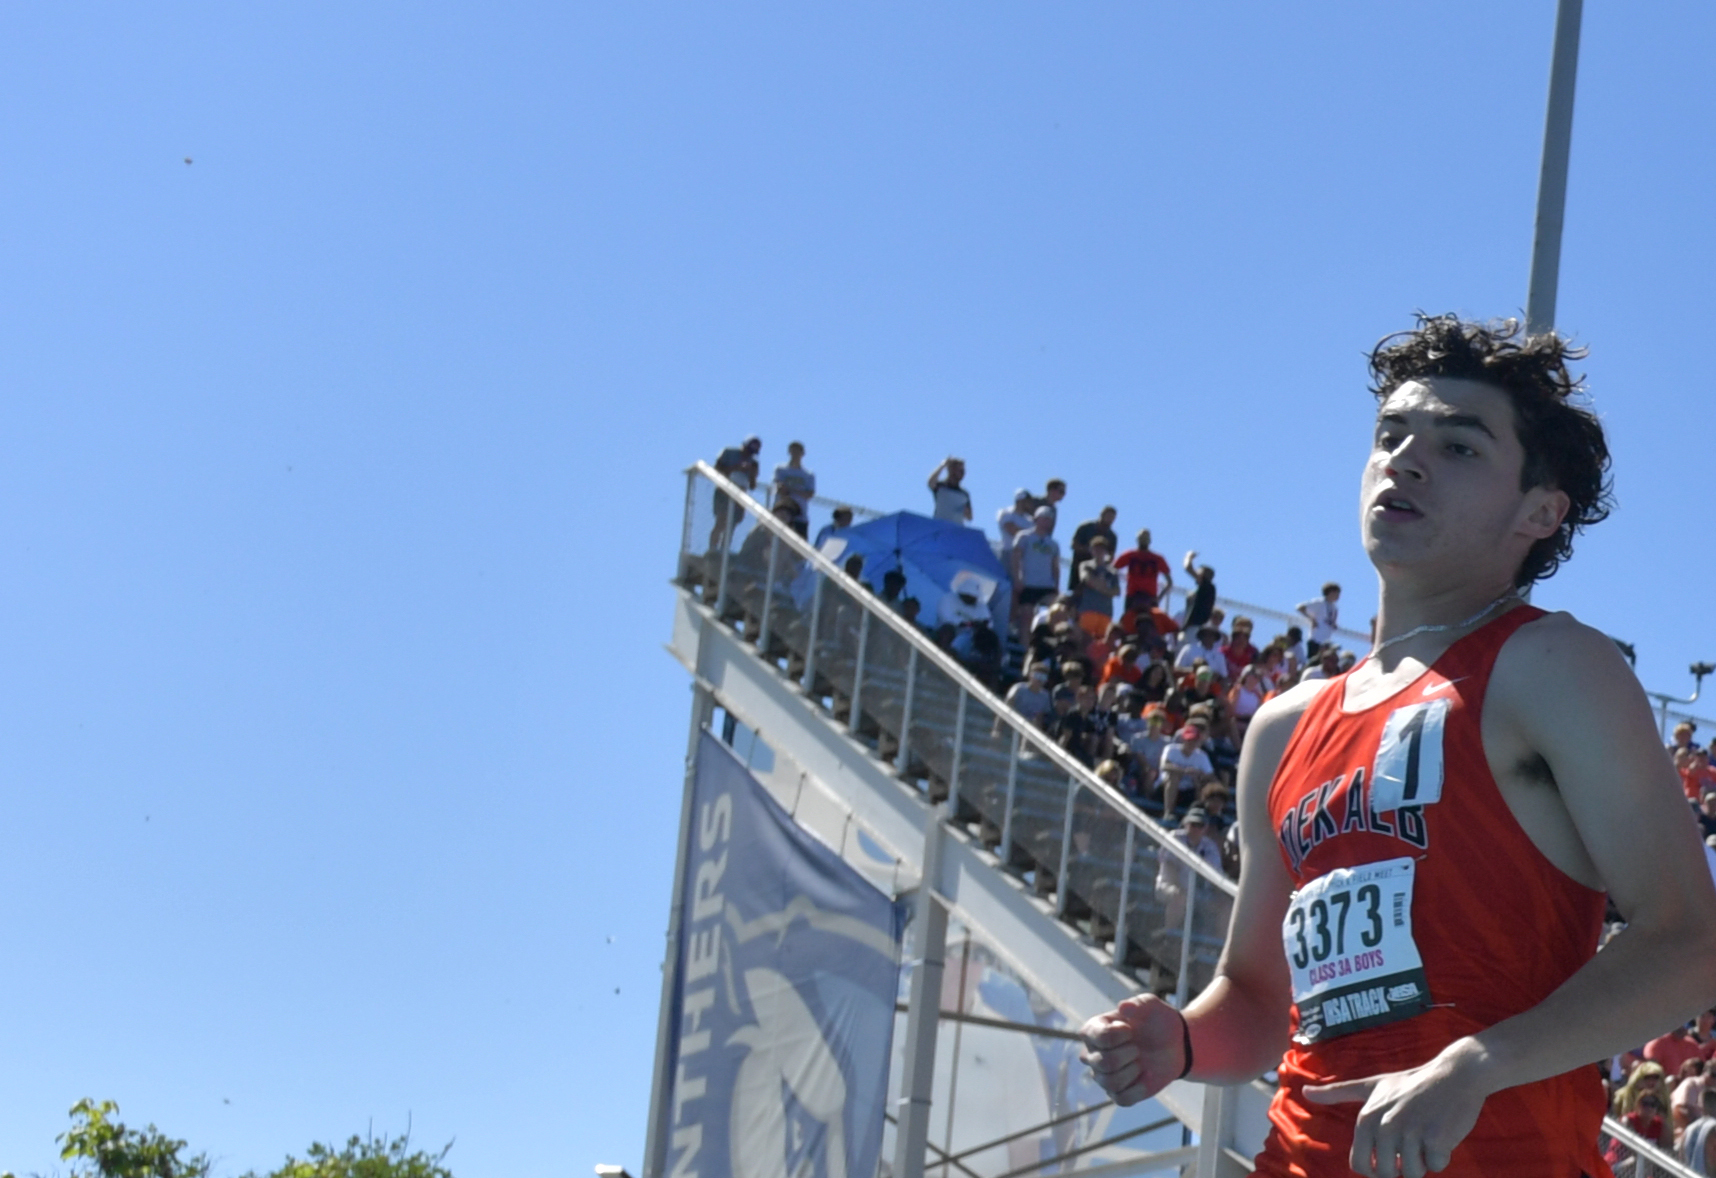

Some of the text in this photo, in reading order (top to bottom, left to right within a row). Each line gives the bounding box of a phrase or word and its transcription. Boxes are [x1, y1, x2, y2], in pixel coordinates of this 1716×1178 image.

[1397, 708, 1428, 801] 1
[1289, 884, 1384, 970] 3373
[1308, 949, 1385, 986] CLASS 3A BOYS
[1350, 986, 1391, 1021] TRACK
